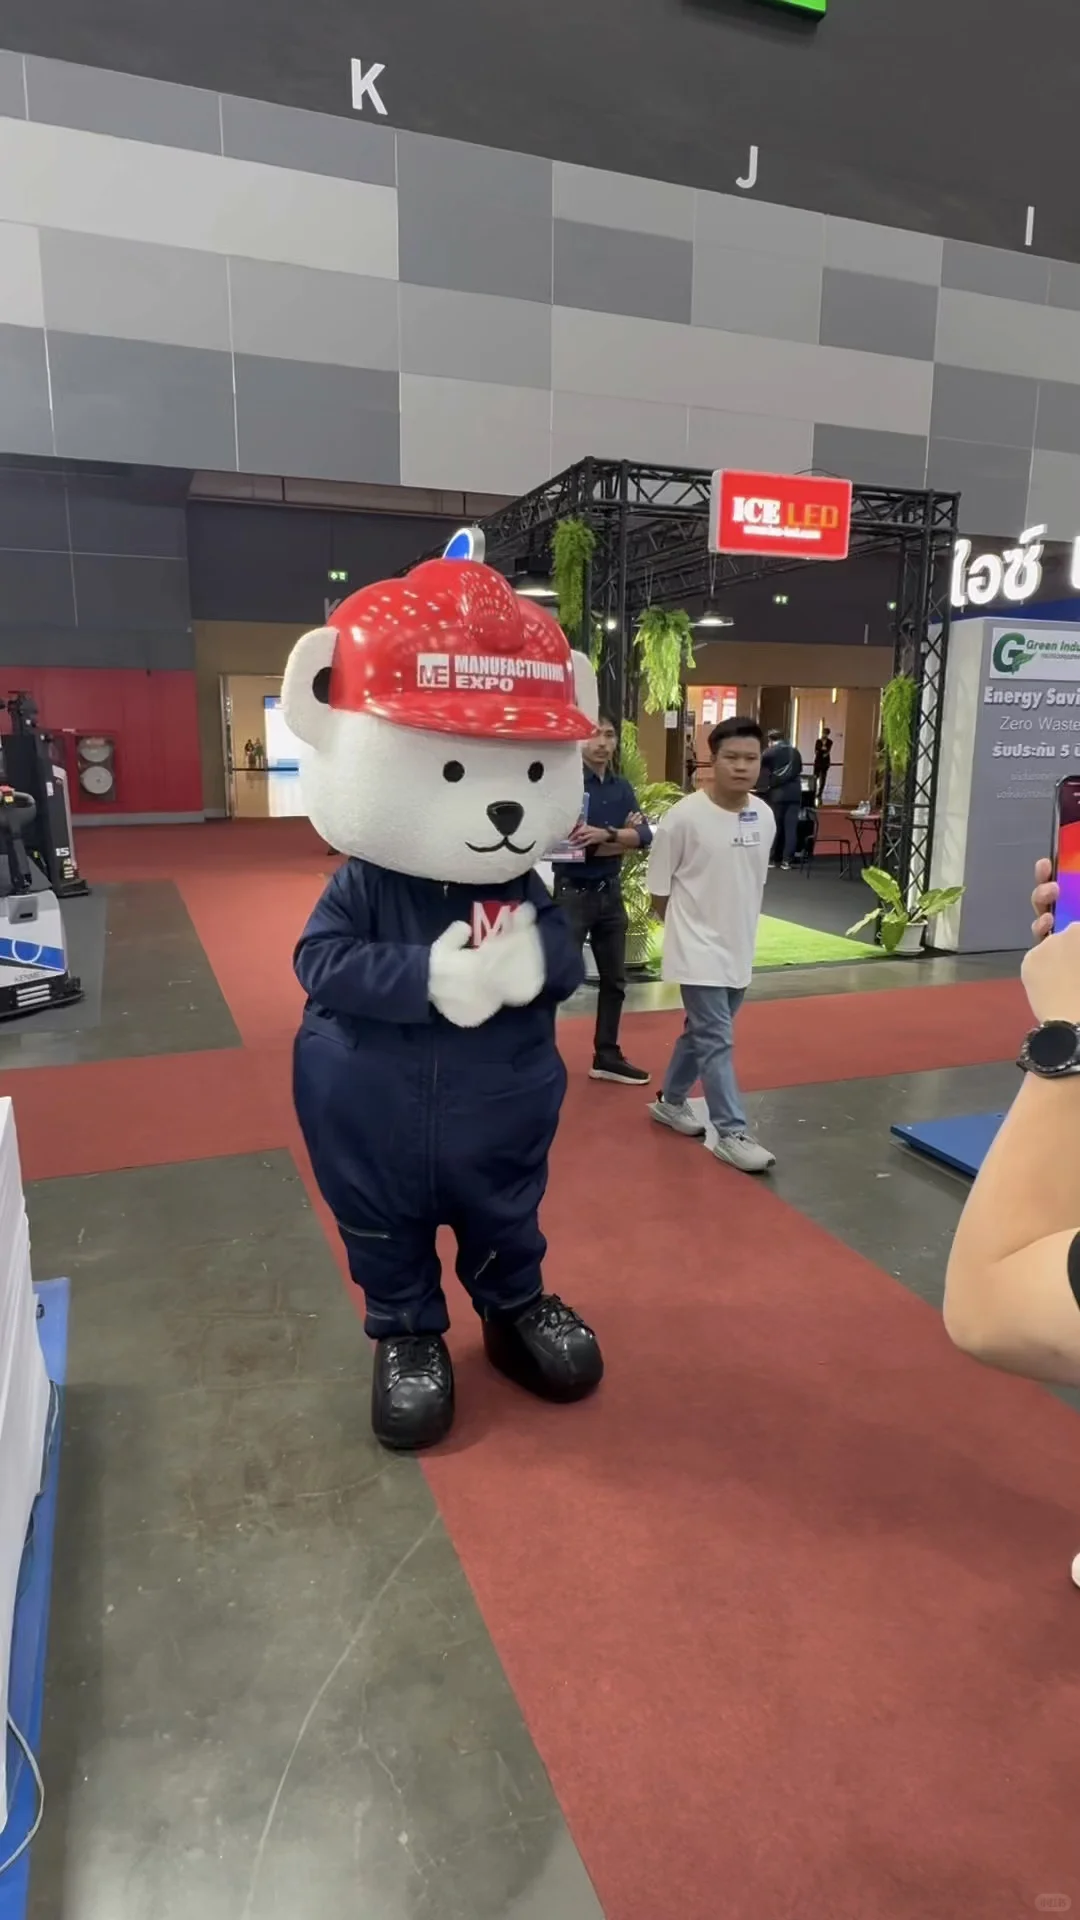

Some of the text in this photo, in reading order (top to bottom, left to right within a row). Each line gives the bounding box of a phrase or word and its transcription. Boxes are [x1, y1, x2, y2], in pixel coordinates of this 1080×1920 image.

[351, 58, 388, 115] K
[735, 145, 759, 189] J
[732, 496, 840, 528] ICE LED
[1026, 639, 1057, 651] Green
[454, 654, 565, 682] MANUFACTURING
[455, 675, 514, 692] EXPO
[984, 686, 1042, 710] Energy
[1000, 716, 1080, 731] Zero Waste
[992, 741, 1056, 757] รับประกัน
[1060, 744, 1070, 757] 5
